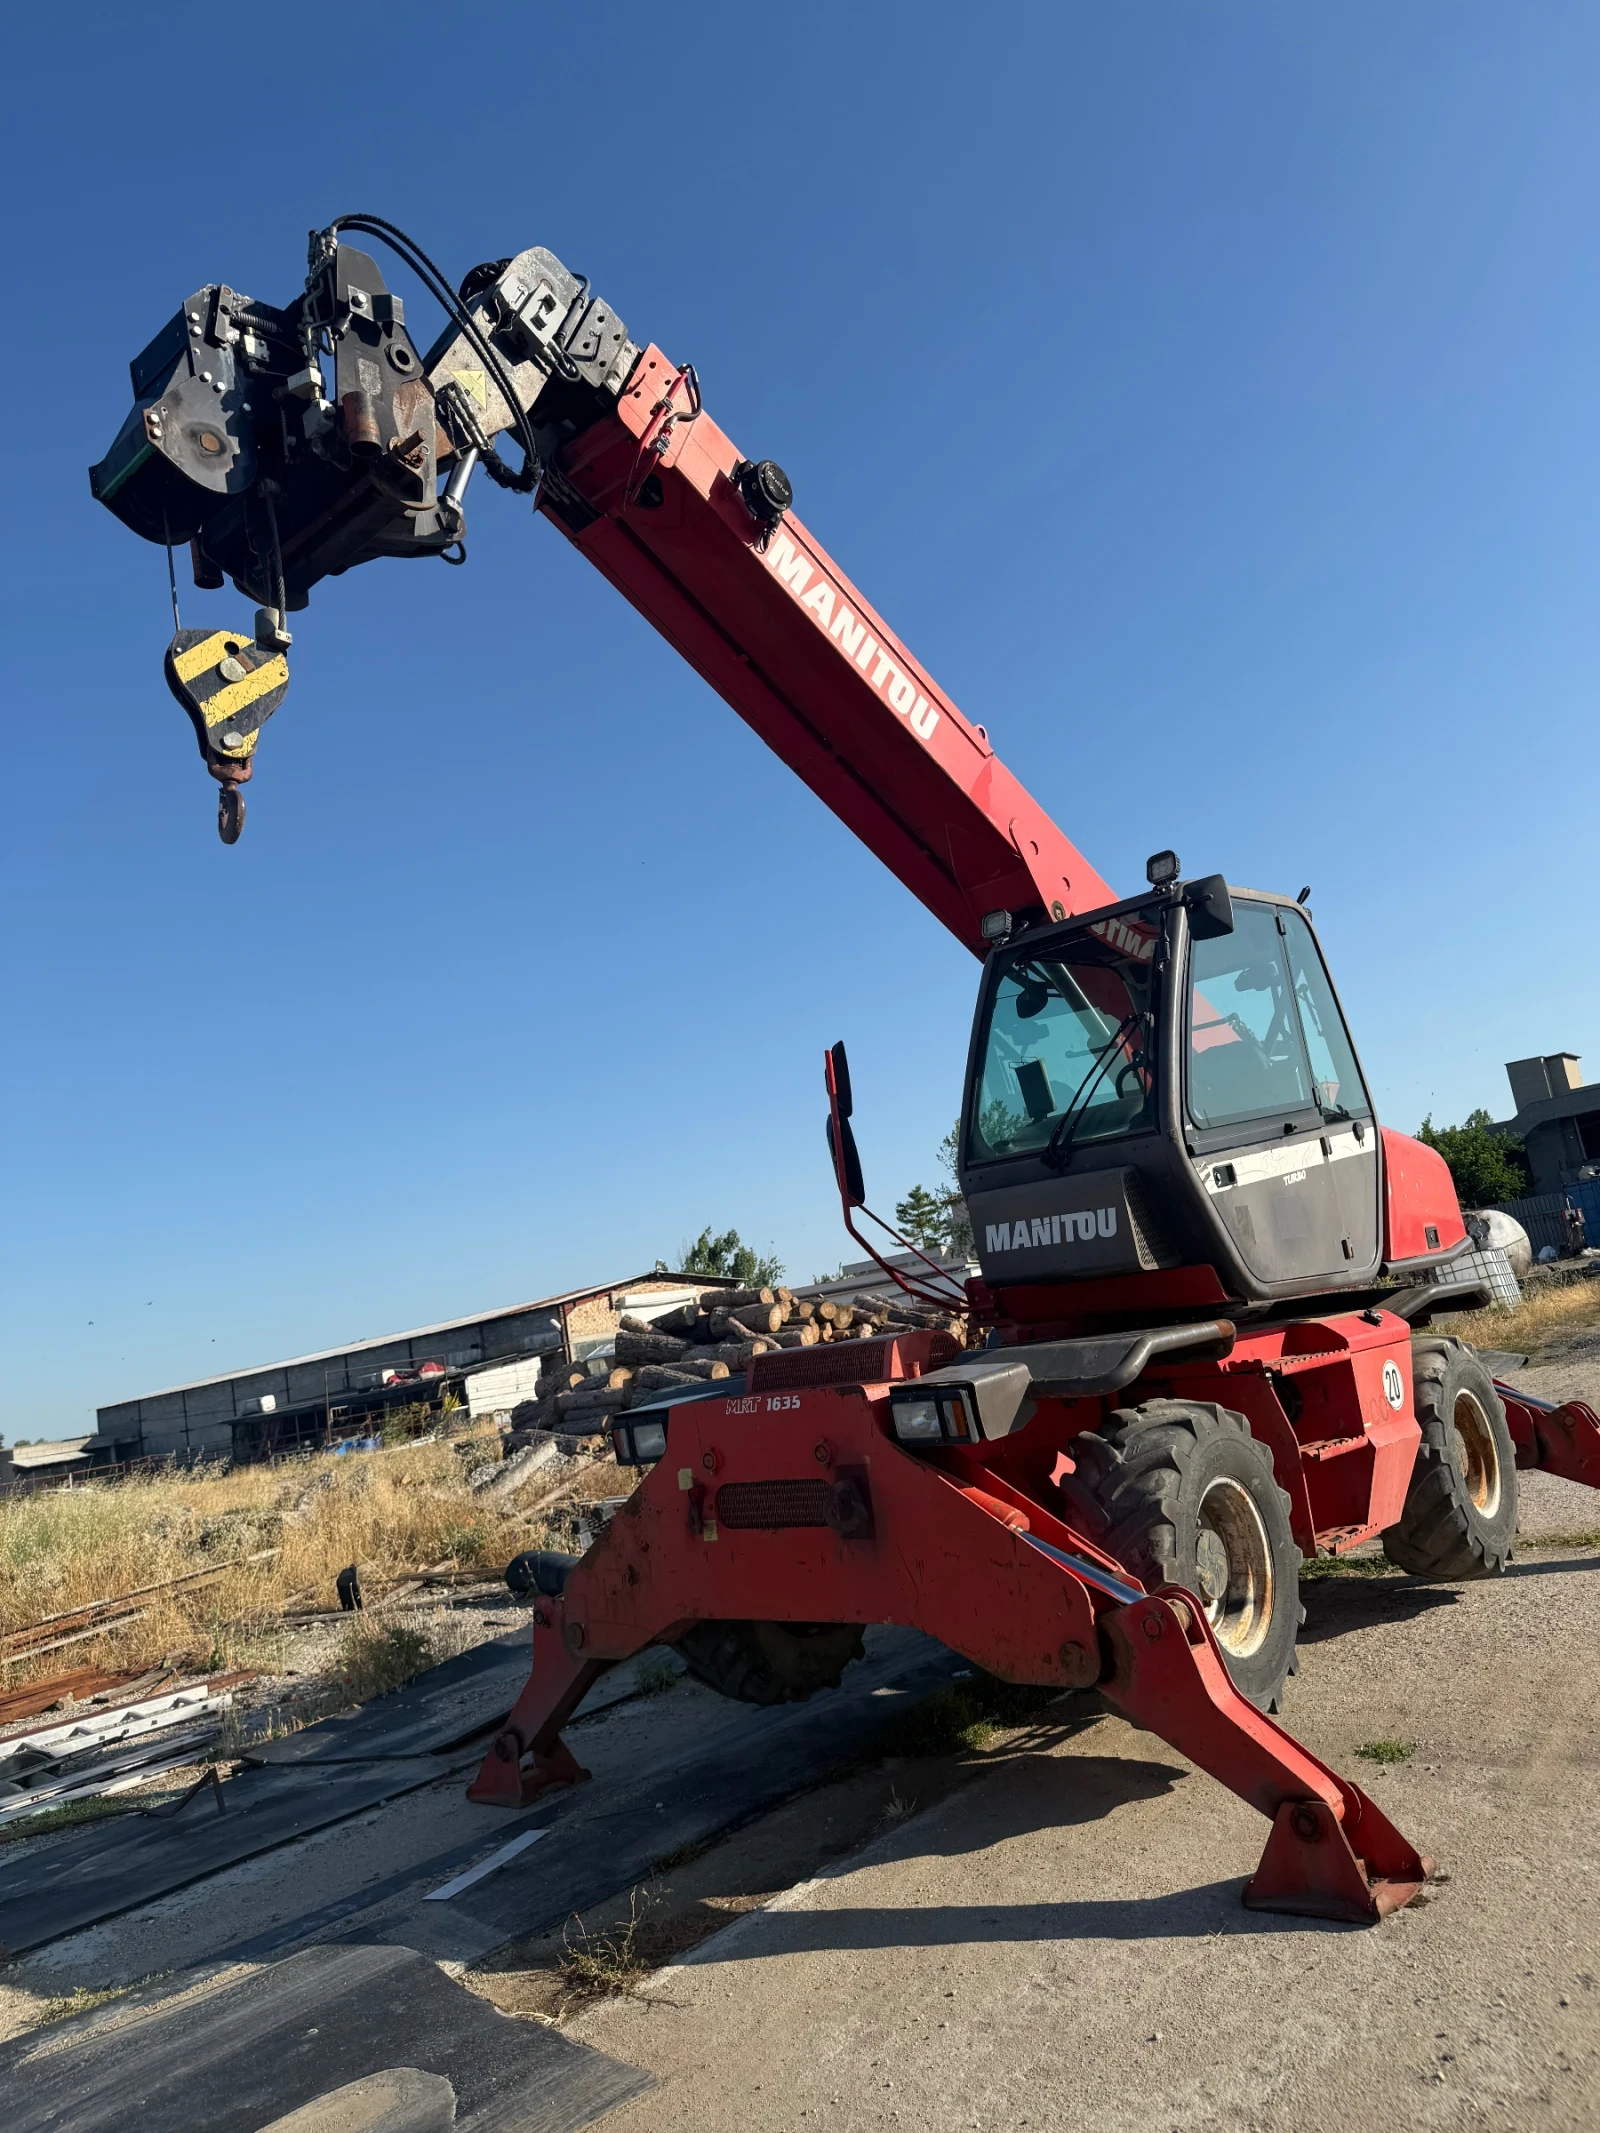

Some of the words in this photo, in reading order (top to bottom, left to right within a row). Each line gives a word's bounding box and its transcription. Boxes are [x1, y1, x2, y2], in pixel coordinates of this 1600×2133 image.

[766, 532, 940, 740] MANITOU
[1283, 1169, 1306, 1186] TURBO
[985, 1206, 1118, 1253] MANITOU
[1385, 1368, 1401, 1402] 20
[726, 1396, 761, 1415] MRT
[766, 1395, 801, 1411] 1635
